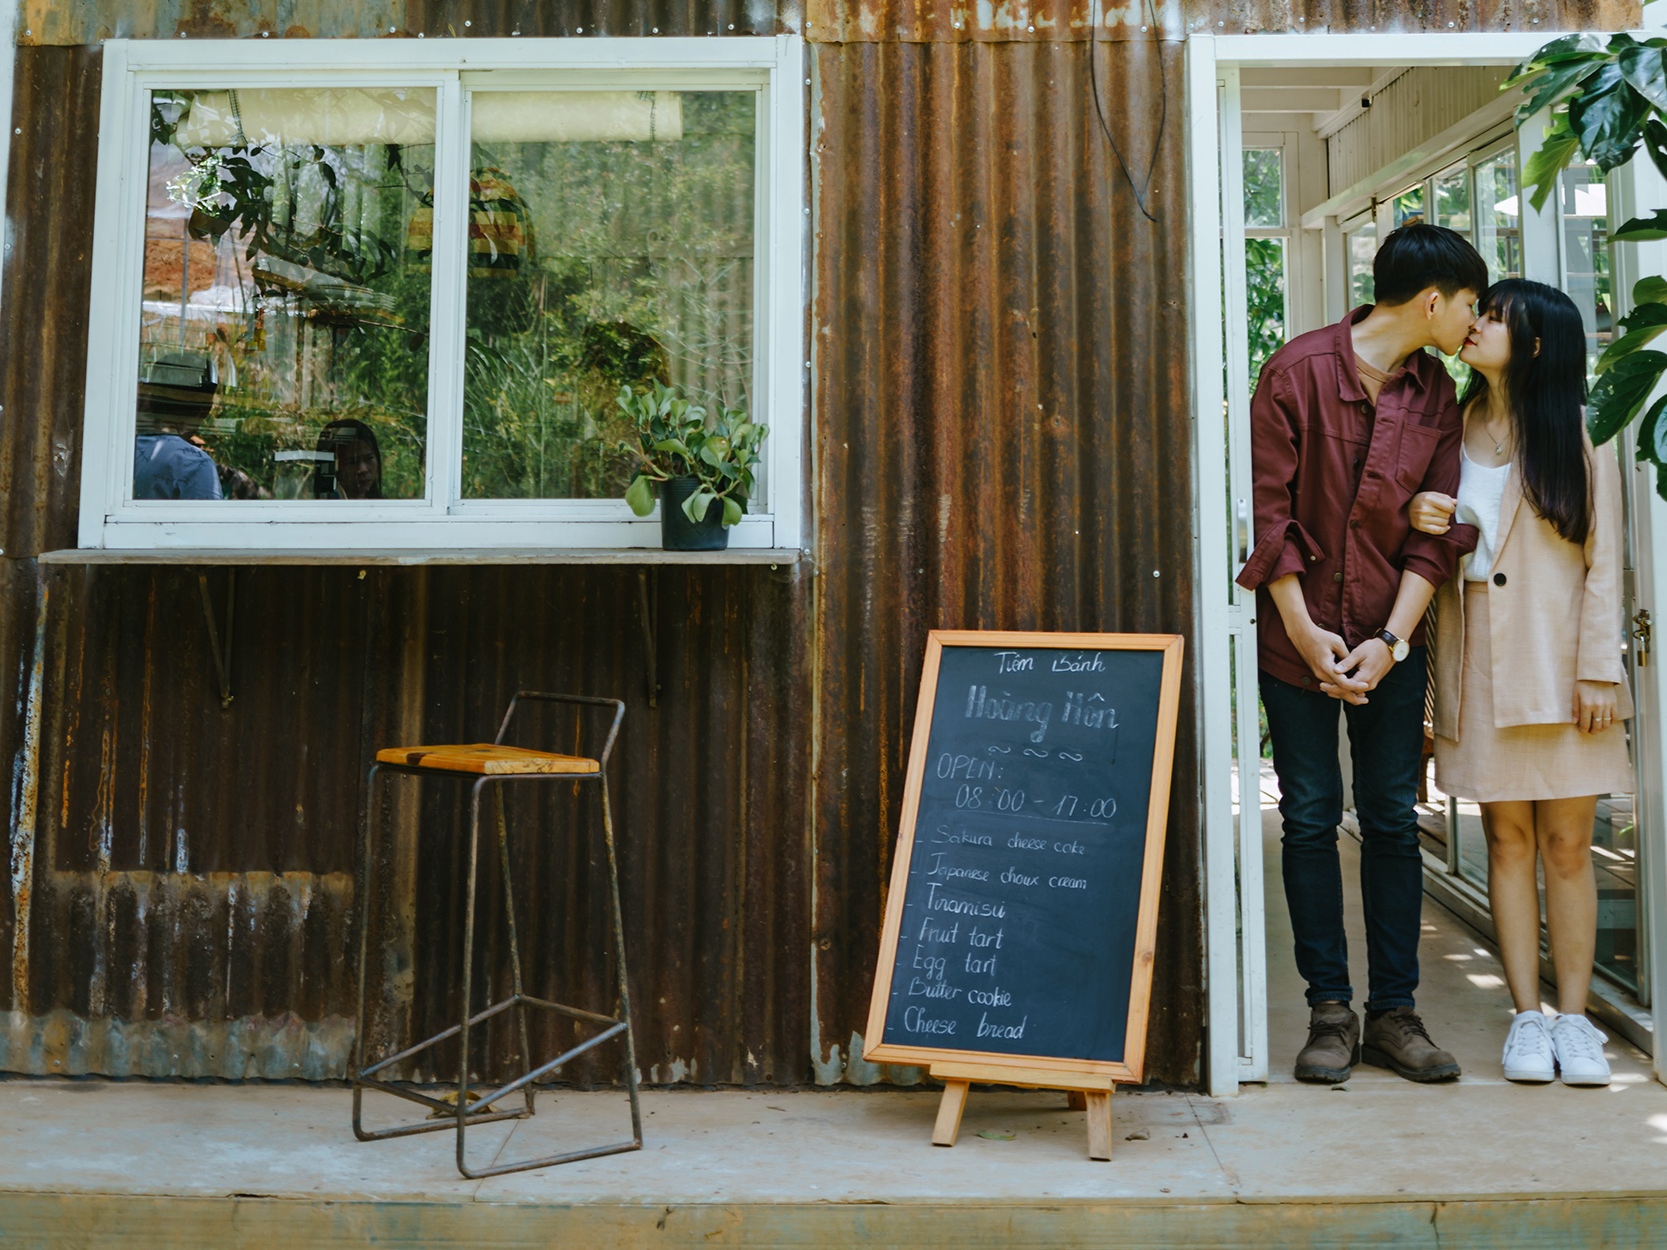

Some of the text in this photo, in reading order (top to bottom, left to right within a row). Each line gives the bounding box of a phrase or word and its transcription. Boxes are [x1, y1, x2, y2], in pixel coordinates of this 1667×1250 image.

[1052, 651, 1106, 673] Bánh
[965, 685, 1119, 743] Hoàng Hôn
[1054, 795, 1117, 819] 17:00
[931, 824, 993, 847] Sakura
[1007, 832, 1046, 850] cheese
[927, 852, 1087, 890] Japanese choux cream
[926, 882, 1006, 919] Tiramisu
[919, 916, 1004, 950] Fruit tart
[913, 944, 996, 980] Egg tart
[908, 976, 1012, 1007] Butter cookie
[904, 1005, 1028, 1039] Cheese bread
